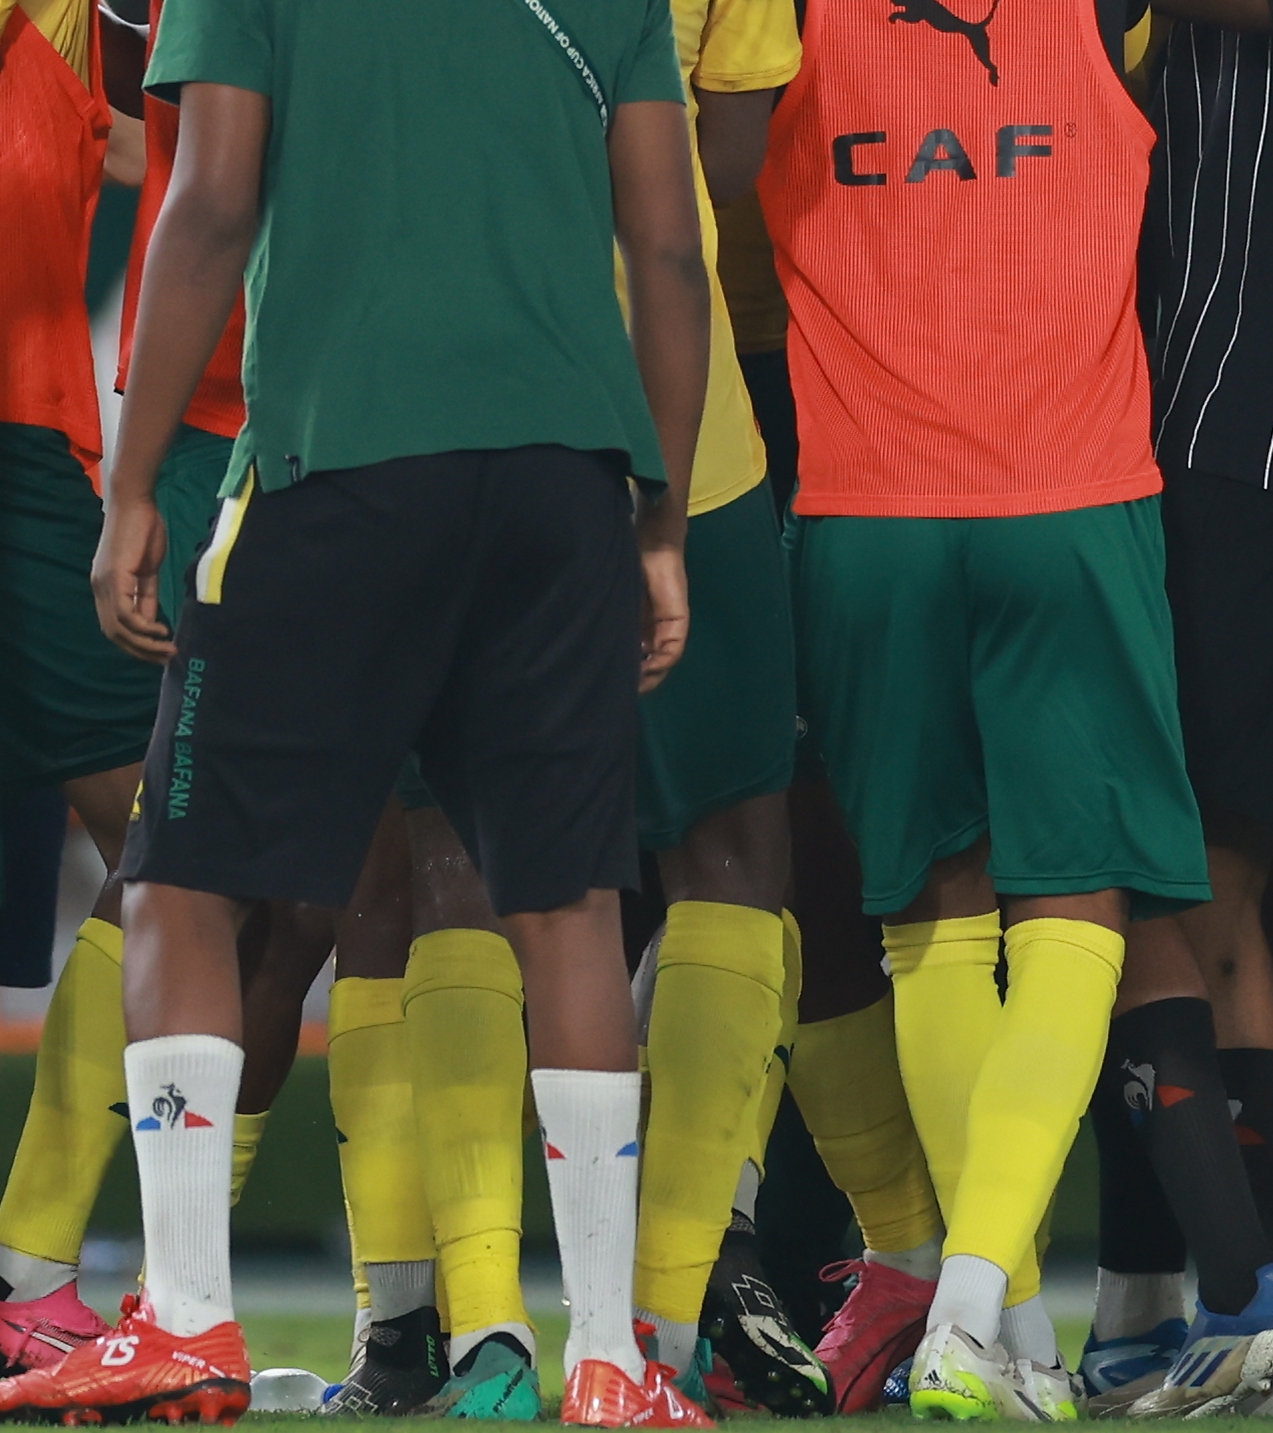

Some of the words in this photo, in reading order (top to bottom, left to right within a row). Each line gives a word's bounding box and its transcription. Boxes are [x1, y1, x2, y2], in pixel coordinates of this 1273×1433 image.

[554, 31, 570, 49] OF
[567, 46, 584, 69] CUP
[832, 124, 1054, 187] CAF
[174, 657, 206, 737] BAFANA
[168, 741, 194, 820] BAFANA
